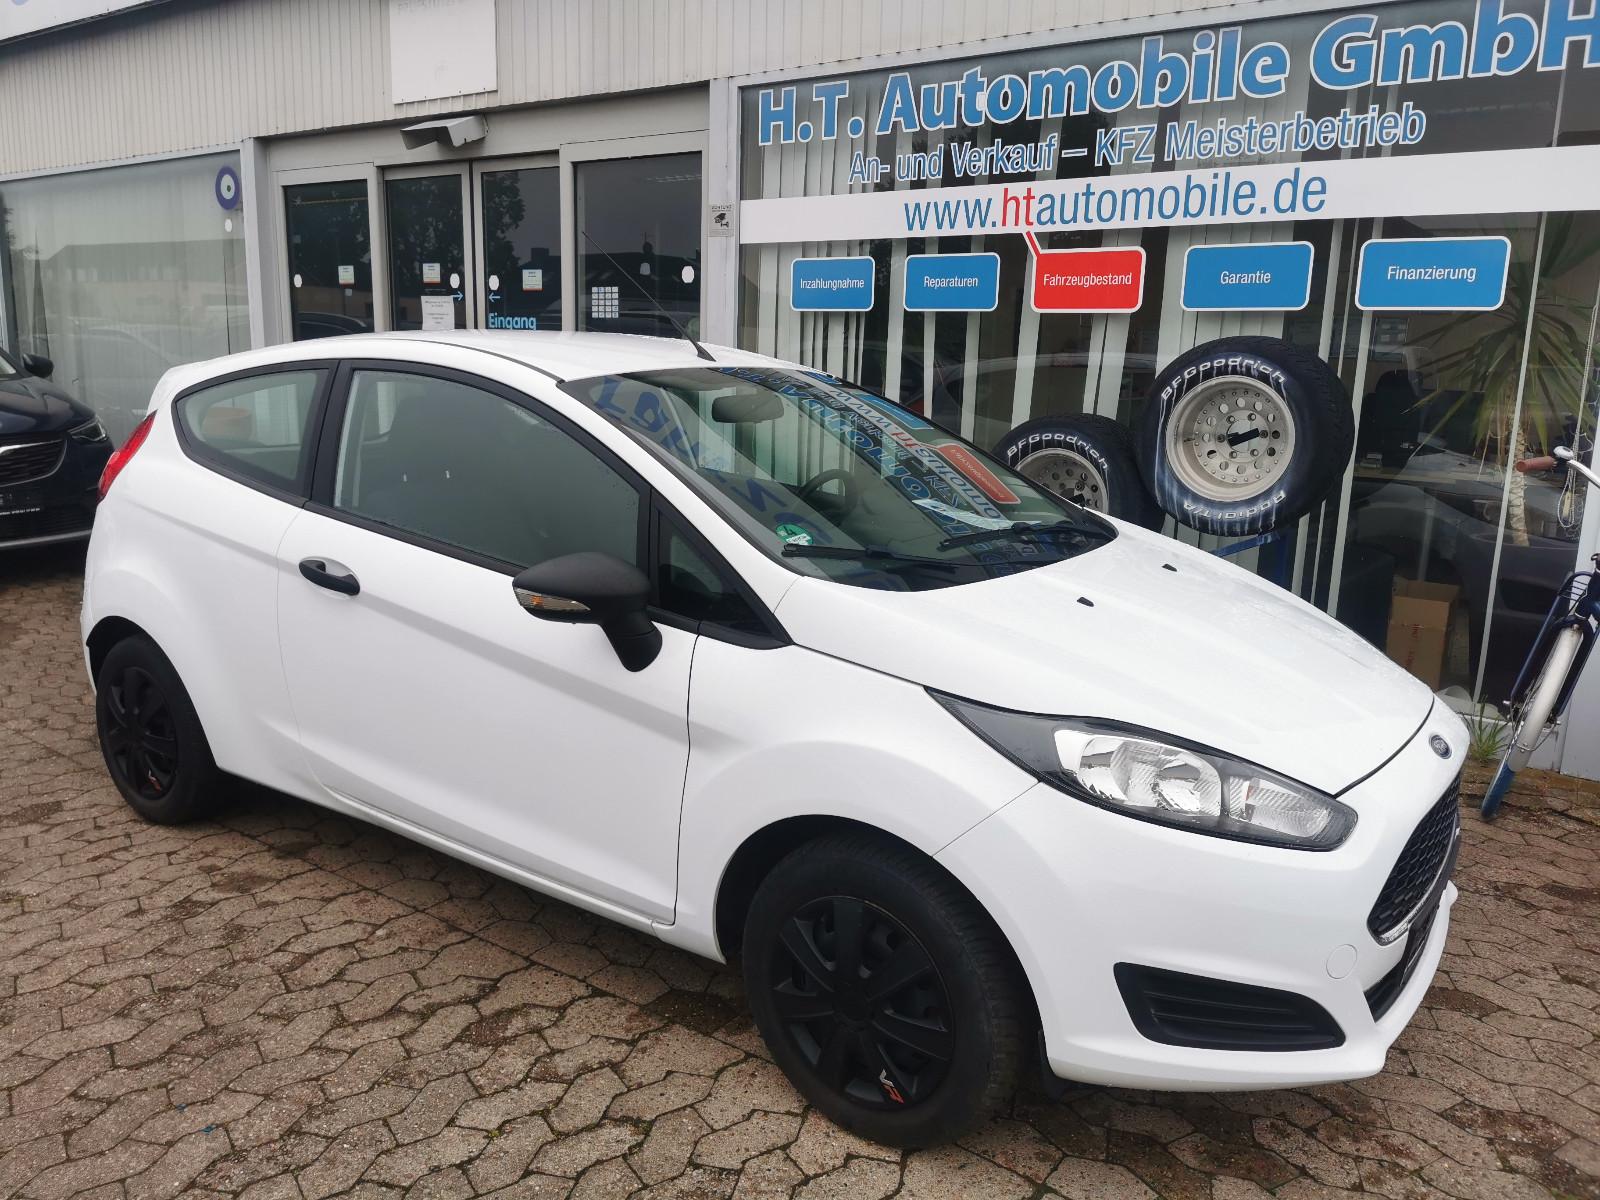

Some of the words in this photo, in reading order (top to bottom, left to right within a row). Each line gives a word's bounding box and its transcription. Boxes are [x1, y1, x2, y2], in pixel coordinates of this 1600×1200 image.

[759, 80, 864, 146] H.T.
[875, 26, 1290, 135] Automobile
[1310, 0, 1600, 90] GmbH
[849, 151, 890, 184] An-
[896, 143, 944, 181] und
[951, 133, 1058, 178] Verkauf
[1094, 124, 1157, 167] KFZ
[1164, 101, 1426, 161] Meisterbetrieb
[903, 167, 1327, 231] www.htautomobile.de
[923, 275, 978, 290] Reparaturen
[1043, 272, 1132, 288] Fahrzeugbestand
[1220, 270, 1271, 285] Garantie
[1387, 265, 1477, 282] Finanzierung
[800, 277, 865, 291] Inzahlungnahme
[488, 312, 537, 330] Eingang
[1161, 356, 1287, 401] BFGoodrich
[1006, 433, 1108, 469] BFGoodrich
